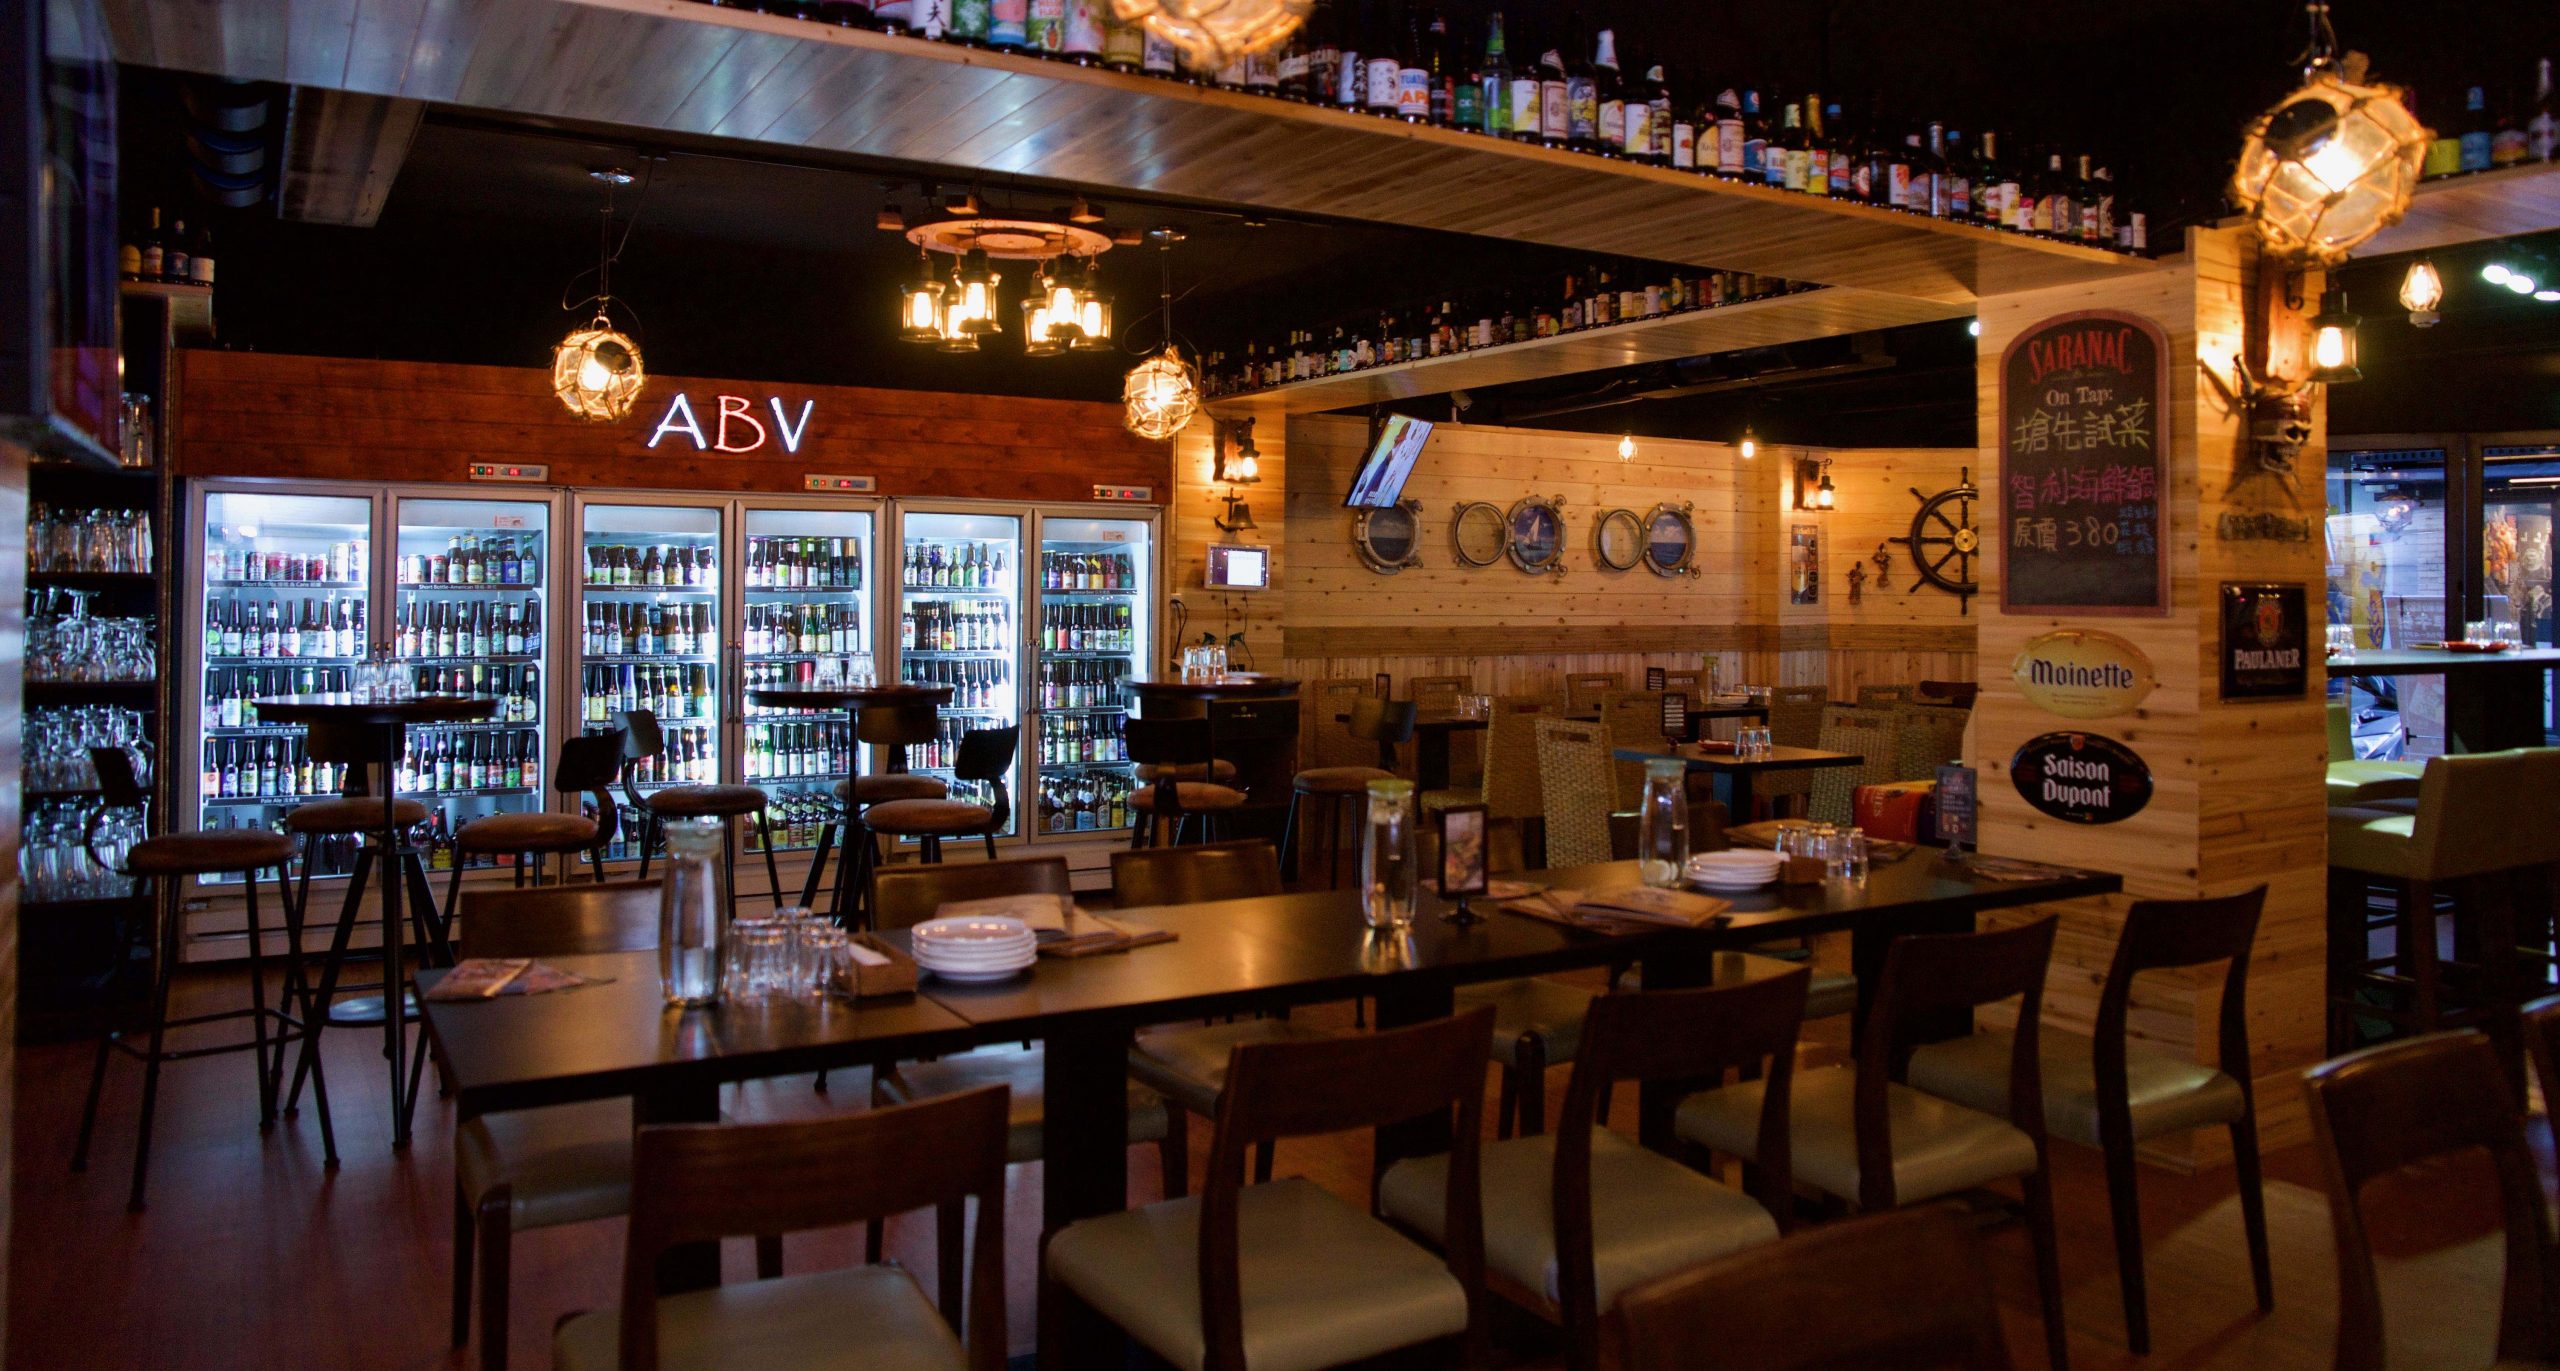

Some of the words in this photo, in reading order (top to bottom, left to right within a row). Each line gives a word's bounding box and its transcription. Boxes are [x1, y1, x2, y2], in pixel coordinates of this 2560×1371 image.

[2028, 328, 2133, 384] SARANAC
[2046, 389, 2070, 406] On
[2076, 386, 2113, 406] Tap:
[648, 393, 814, 453] ABV
[2012, 397, 2150, 455] 搶先試菜
[241, 580, 256, 588] Short
[2031, 659, 2133, 689] Moinette
[2234, 648, 2300, 670] PAULANER
[2043, 754, 2110, 782] Saison
[2042, 778, 2111, 808] Dupont
